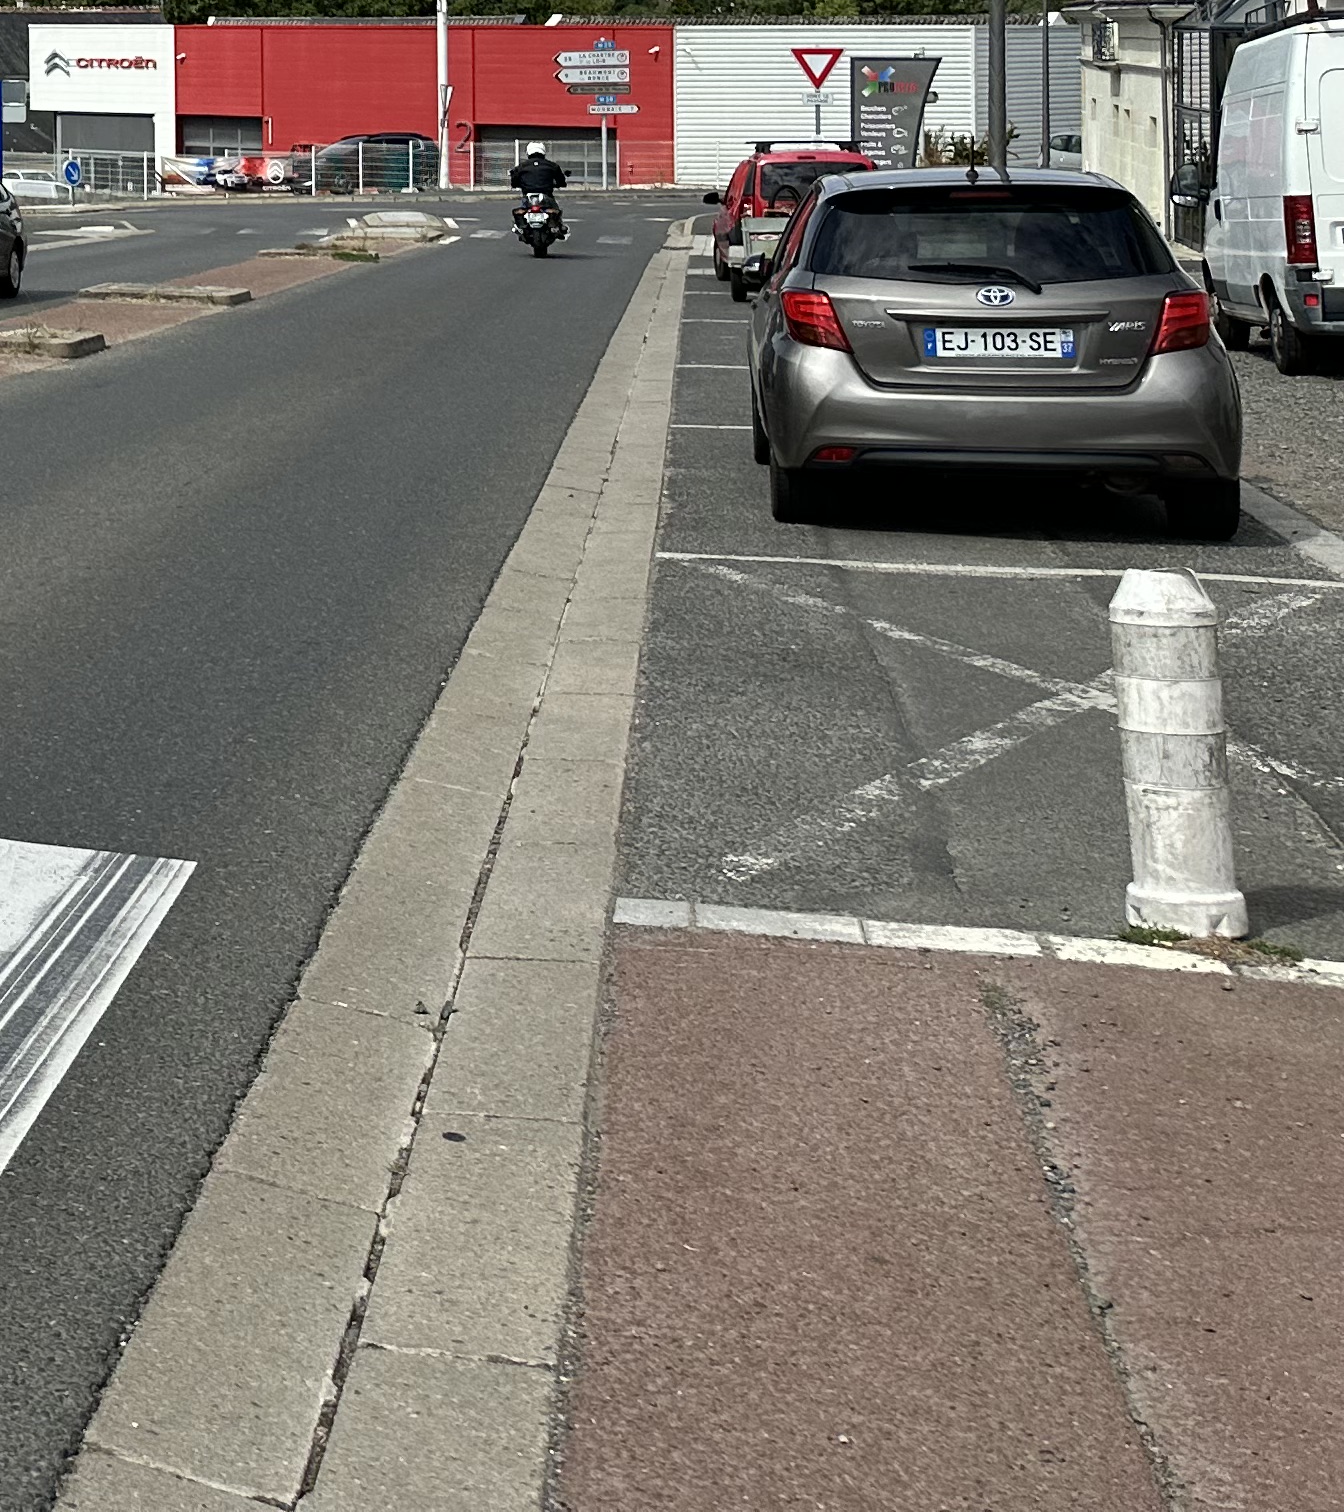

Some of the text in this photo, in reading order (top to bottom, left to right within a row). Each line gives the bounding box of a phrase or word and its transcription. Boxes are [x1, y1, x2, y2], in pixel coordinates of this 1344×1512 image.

[1108, 320, 1147, 332] YARIS
[941, 331, 1057, 352] EJ-103-SE
[1062, 343, 1073, 353] 37
